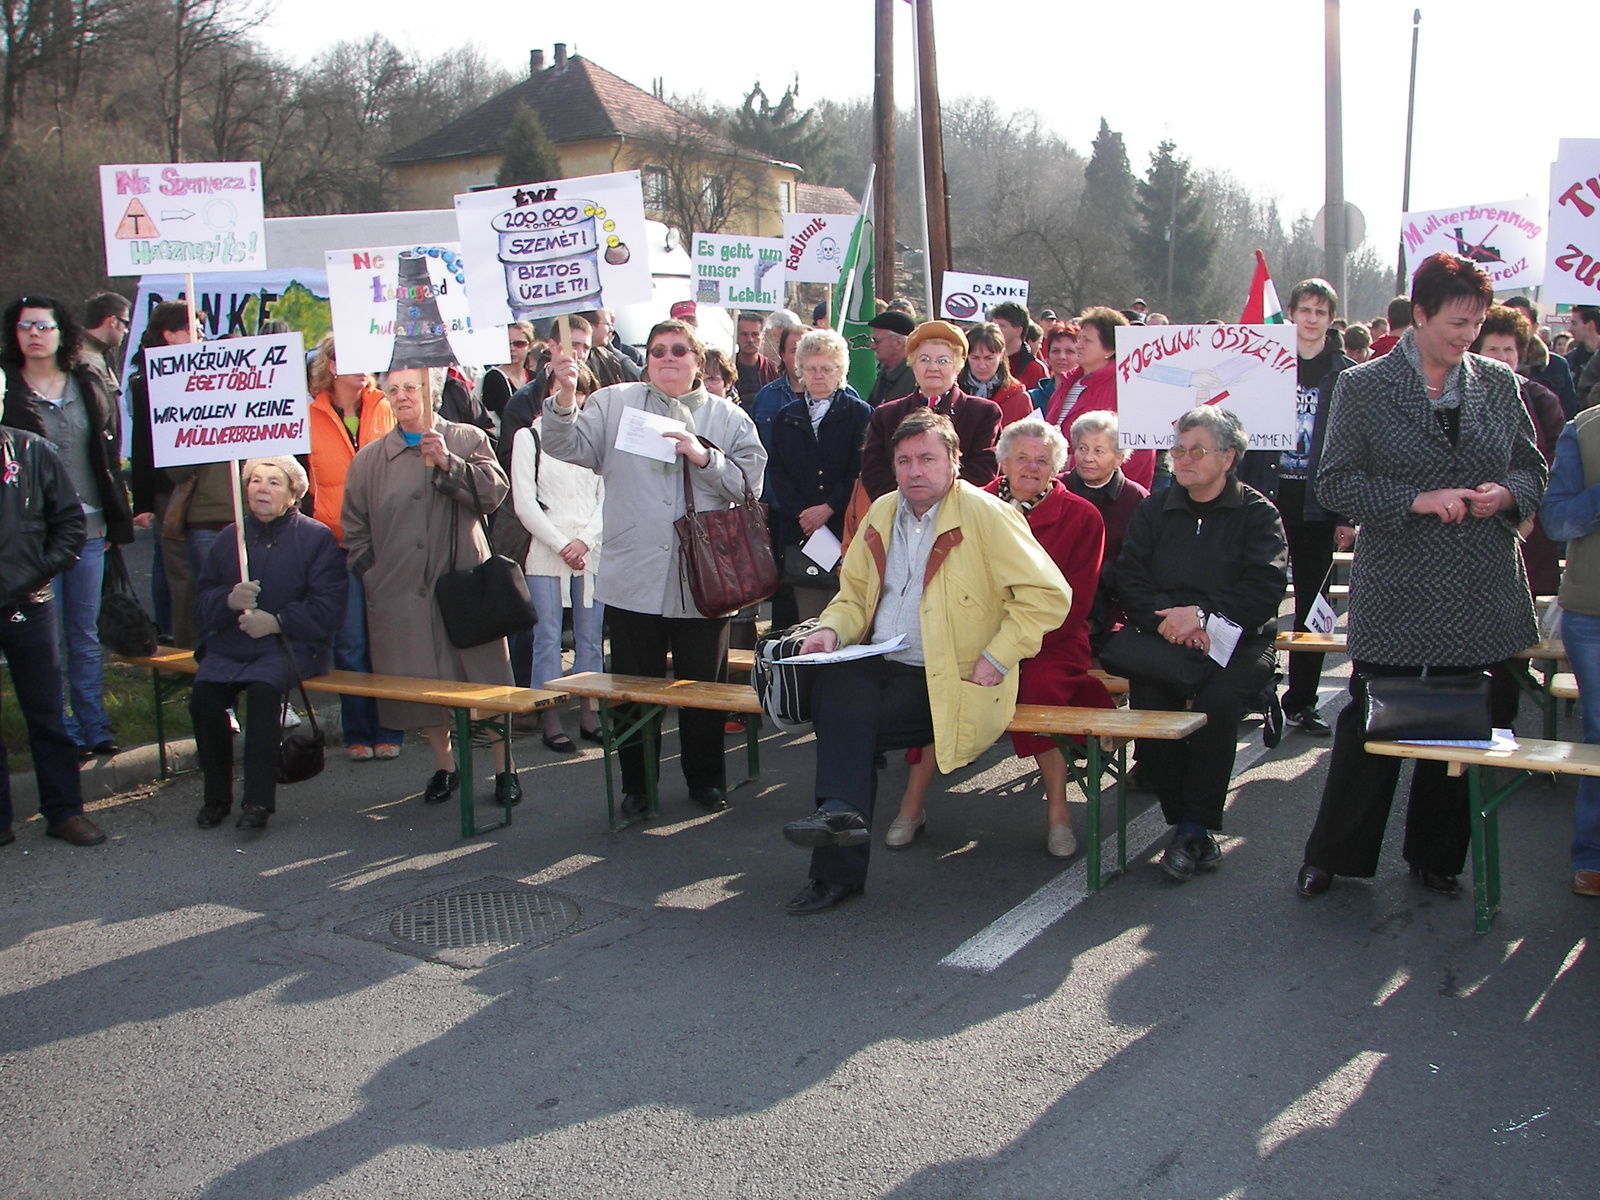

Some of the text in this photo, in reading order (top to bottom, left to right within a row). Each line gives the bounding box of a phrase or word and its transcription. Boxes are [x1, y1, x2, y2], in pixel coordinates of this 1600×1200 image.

[503, 210, 537, 228] 200
[542, 206, 578, 222] 000
[524, 220, 563, 229] tonna
[697, 240, 783, 262] Es geht um
[785, 217, 827, 271] Fogjunk
[352, 252, 385, 270] Ne
[518, 263, 581, 280] BIZTOS
[697, 263, 741, 278] unser
[519, 278, 589, 300] ÜZLET?!
[728, 286, 777, 304] Leben!
[150, 345, 288, 380] NEM KÉRÜNK AZ
[153, 399, 295, 424] WIR WOLLEN KEINE
[174, 418, 304, 448] MÜLLVERBRENNUNG!
[1120, 432, 1146, 446] TUN
[1248, 433, 1292, 447] AMMEN
